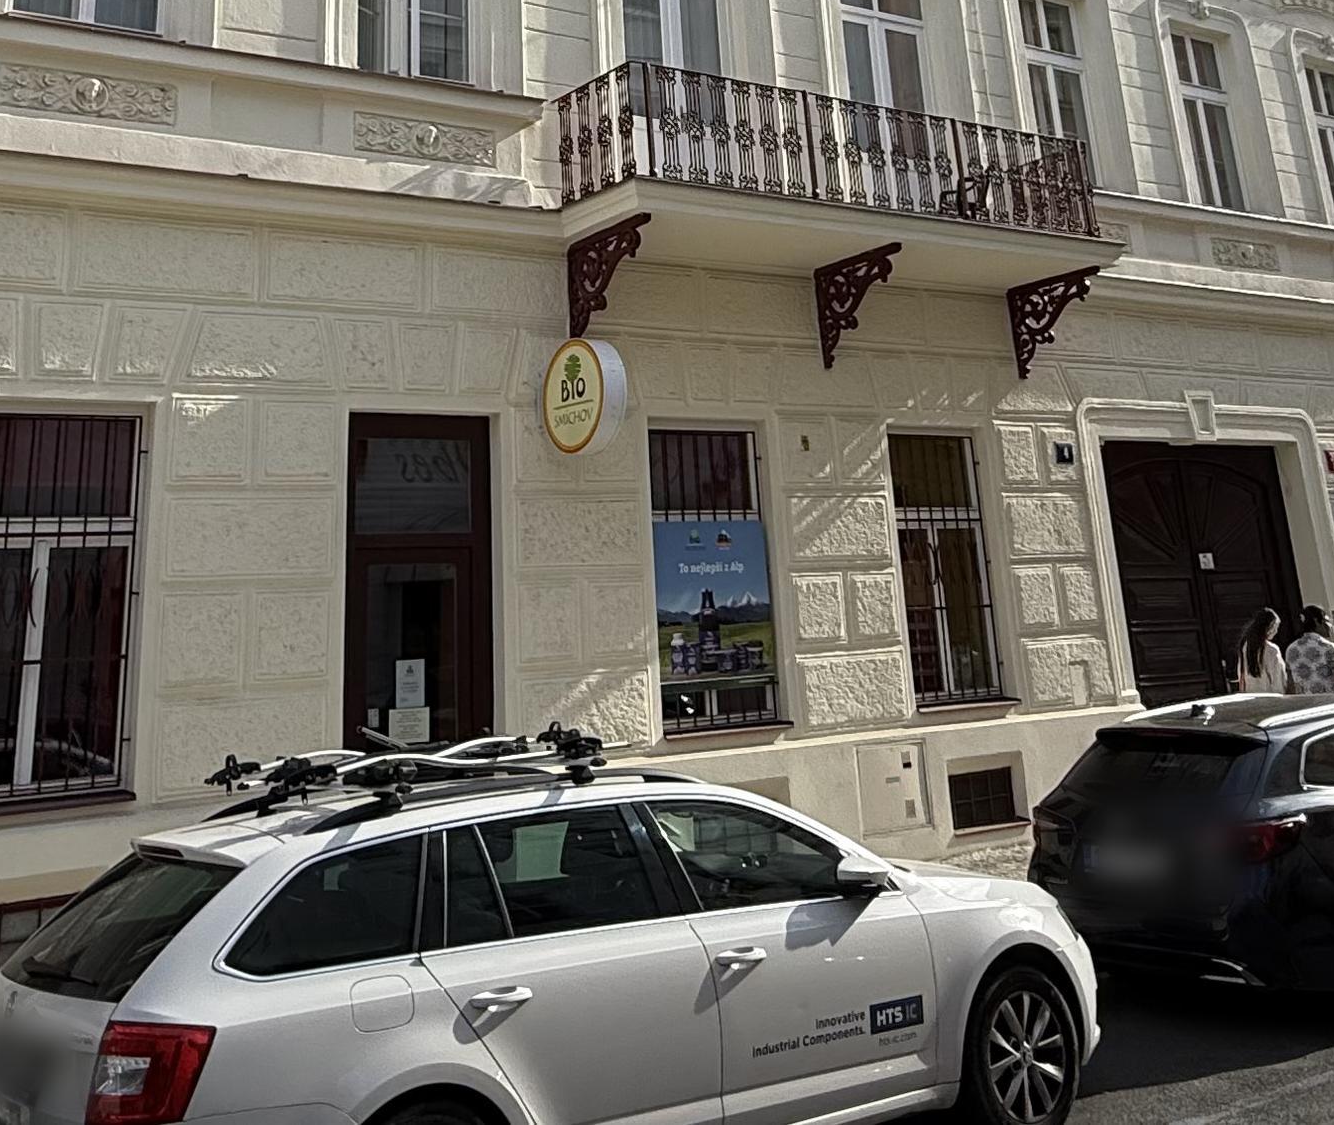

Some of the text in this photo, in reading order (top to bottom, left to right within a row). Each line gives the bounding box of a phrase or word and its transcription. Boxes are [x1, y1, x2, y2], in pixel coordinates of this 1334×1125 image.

[561, 378, 586, 402] BIO
[678, 562, 689, 574] To
[690, 561, 724, 575] nejlepší
[730, 561, 744, 574] Alp
[816, 1011, 866, 1030] Innovative
[876, 1006, 903, 1027] HTS
[752, 1037, 800, 1058] Industrial
